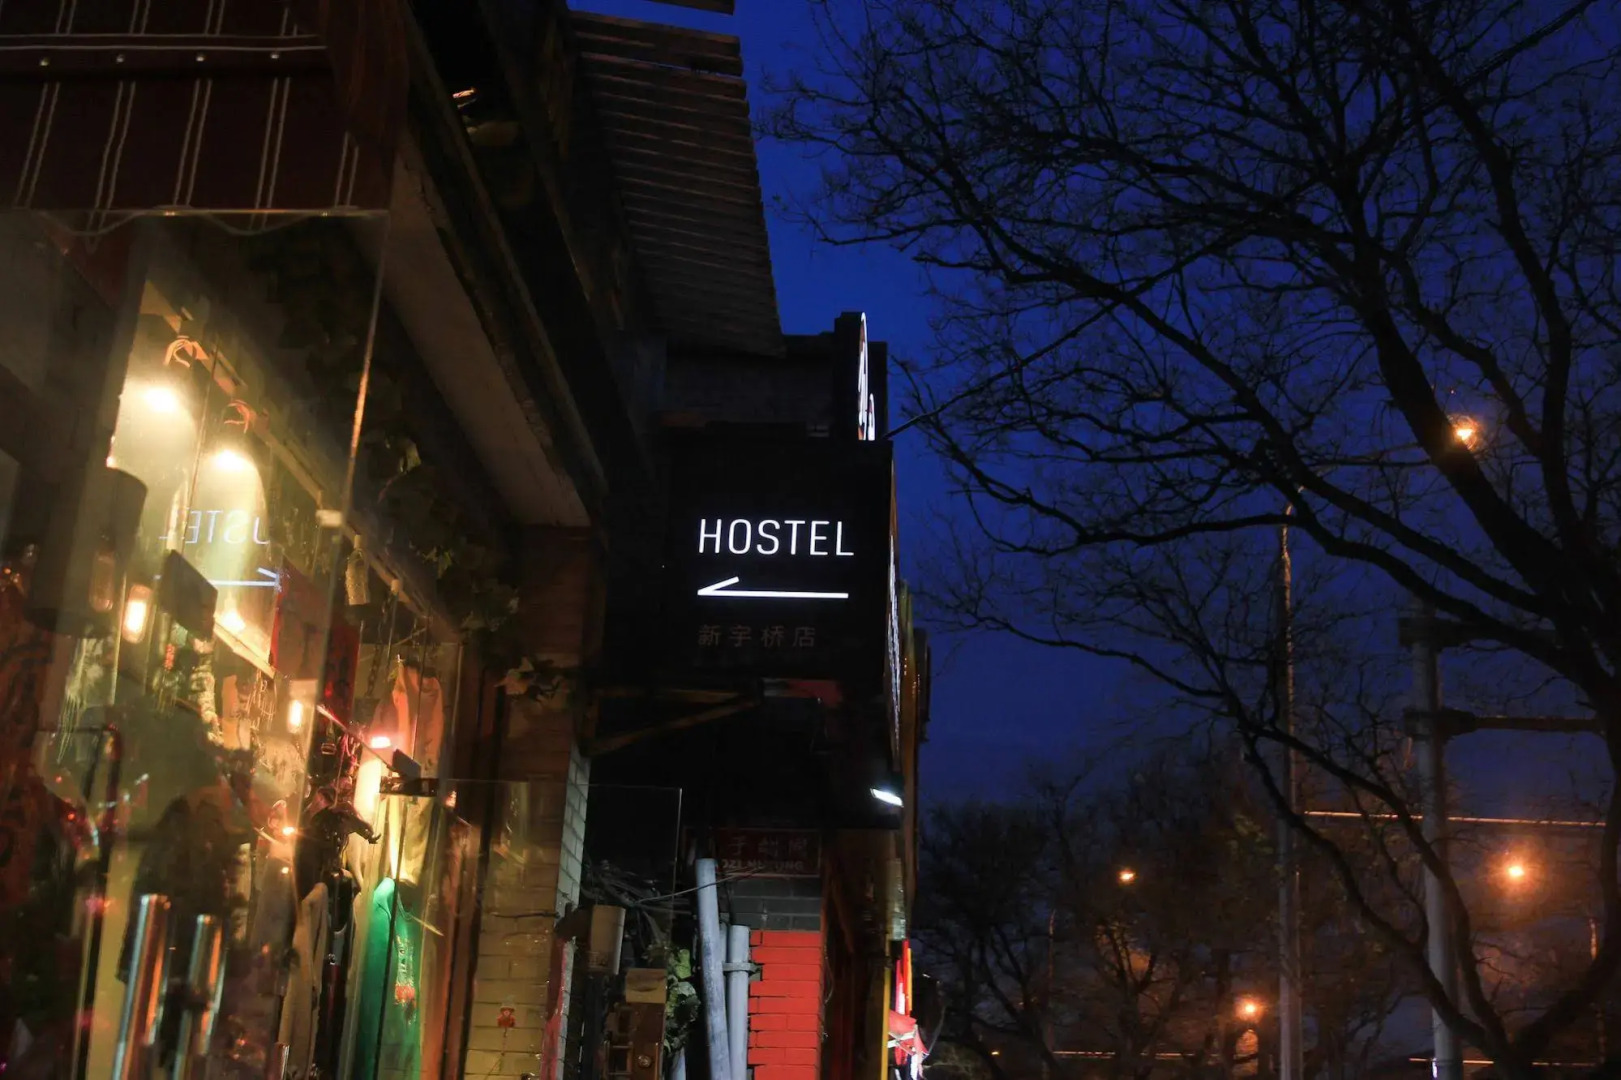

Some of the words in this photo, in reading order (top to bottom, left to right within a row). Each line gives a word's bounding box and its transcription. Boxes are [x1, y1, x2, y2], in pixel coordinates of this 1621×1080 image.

[698, 518, 855, 556] HOSTEL
[697, 623, 816, 648] 新宇桥店
